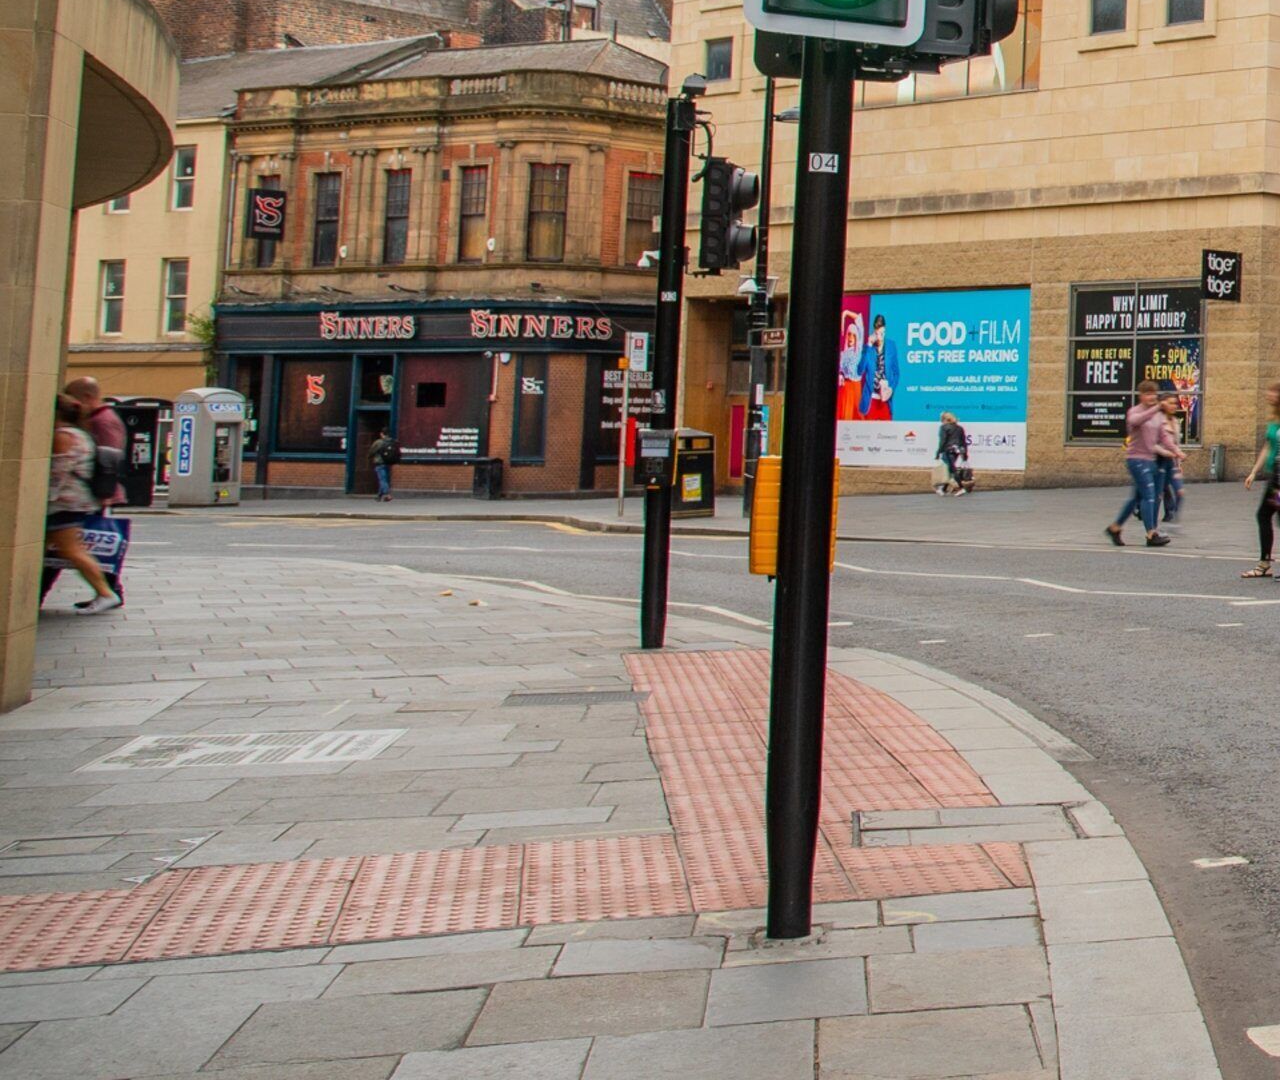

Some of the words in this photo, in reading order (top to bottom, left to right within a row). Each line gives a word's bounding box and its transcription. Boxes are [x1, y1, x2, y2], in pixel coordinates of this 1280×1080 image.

[811, 153, 837, 171] 04
[1207, 252, 1236, 275] tiger
[1206, 275, 1235, 298] tiger
[1112, 295, 1136, 312] WHY
[1140, 294, 1169, 310] LIMIT
[319, 311, 417, 341] SINNERS
[471, 309, 613, 341] SINNERS
[1086, 314, 1117, 330] HAPPY
[1120, 313, 1132, 329] TO
[1137, 313, 1150, 329] AN
[1153, 311, 1187, 328] HOUR?
[907, 322, 966, 346] FOOD
[979, 319, 1021, 345] FILM
[907, 350, 935, 363] GETS
[938, 350, 965, 363] FREE
[968, 348, 1019, 363] PARKING
[1076, 349, 1090, 360] BUY
[1091, 349, 1103, 360] ONE
[1105, 348, 1117, 360] GET
[1118, 348, 1132, 359] ONE
[1153, 349, 1160, 364] 5
[629, 371, 653, 381] REBLES
[946, 375, 981, 384] AVAILABLE
[983, 375, 1003, 383] EVERY
[1005, 375, 1018, 383] DAY
[1145, 365, 1173, 380] EVERY
[1176, 364, 1195, 380] DAY
[180, 420, 191, 471] CASH
